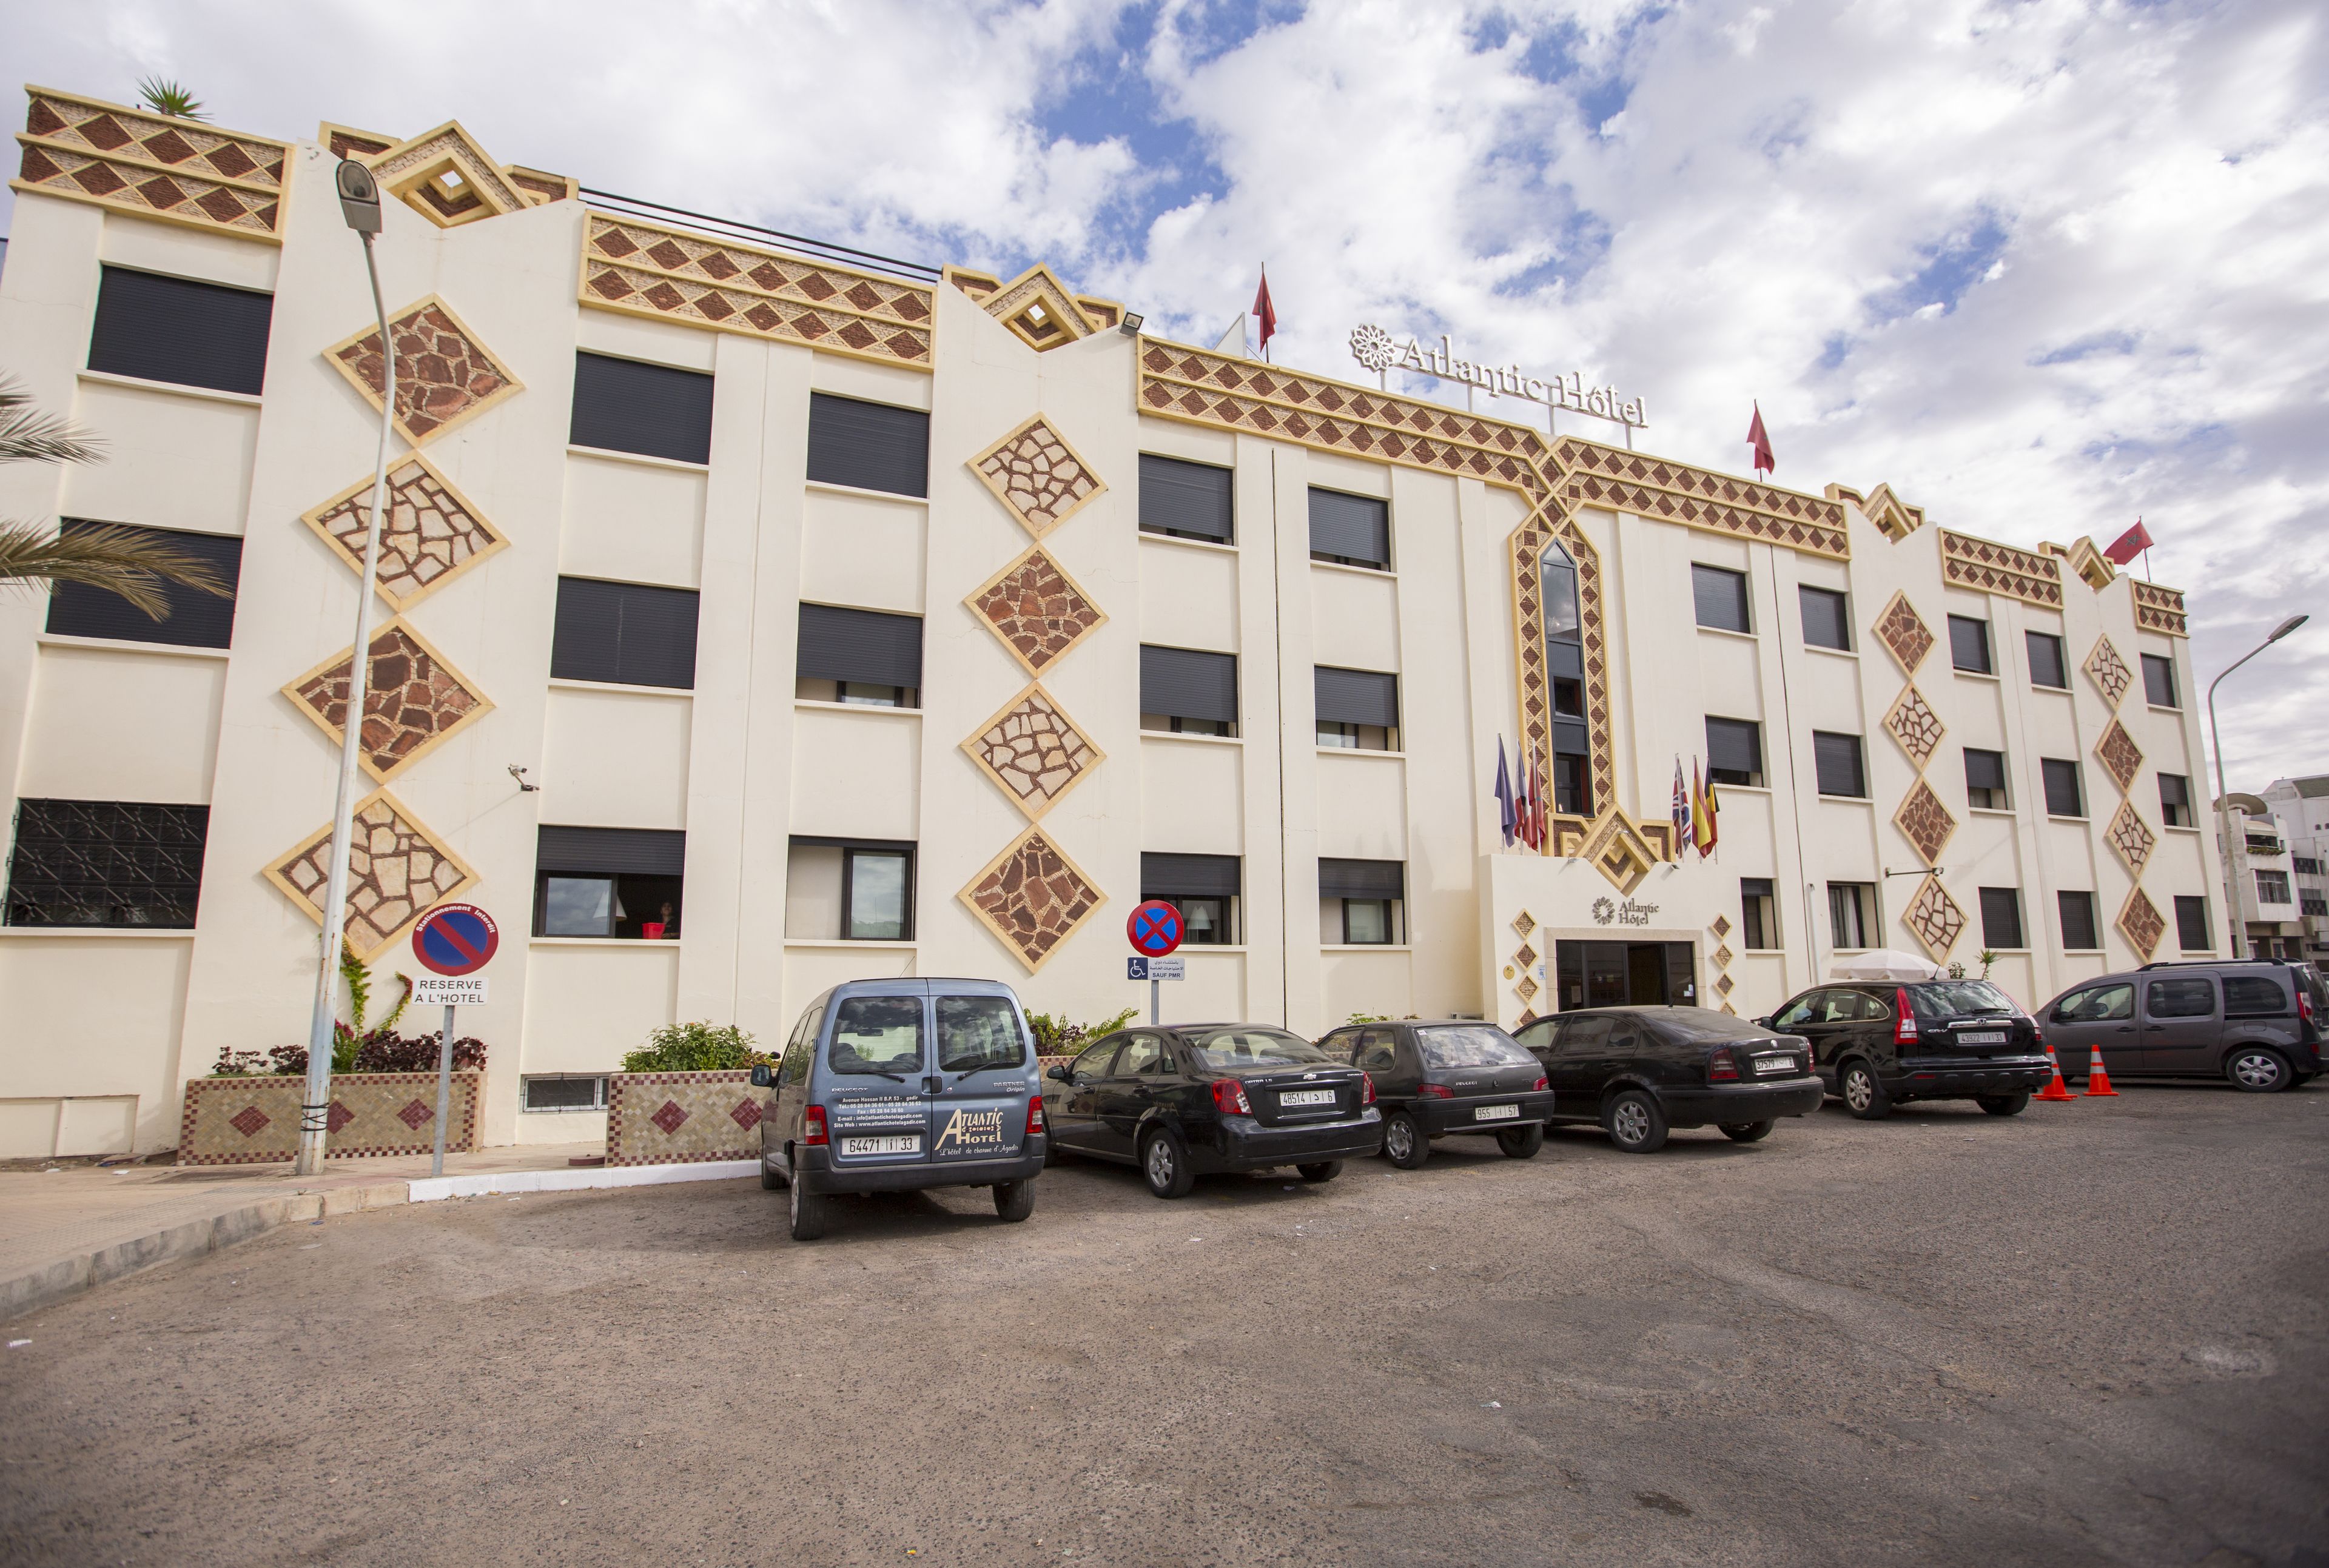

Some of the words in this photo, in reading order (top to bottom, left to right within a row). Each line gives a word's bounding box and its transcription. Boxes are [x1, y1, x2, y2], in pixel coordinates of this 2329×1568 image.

[1398, 334, 1544, 398] Atlantic
[1554, 370, 1649, 428] Hôtel
[1619, 898, 1659, 913] Atlantic
[416, 905, 471, 932] Stationnement
[474, 910, 496, 933] Interdit
[1618, 911, 1648, 926] Hôtel
[420, 980, 482, 990] RESERVE
[429, 994, 484, 1003] L'HOTEL
[901, 1137, 913, 1150] 33
[961, 1131, 1002, 1144] HOTEL
